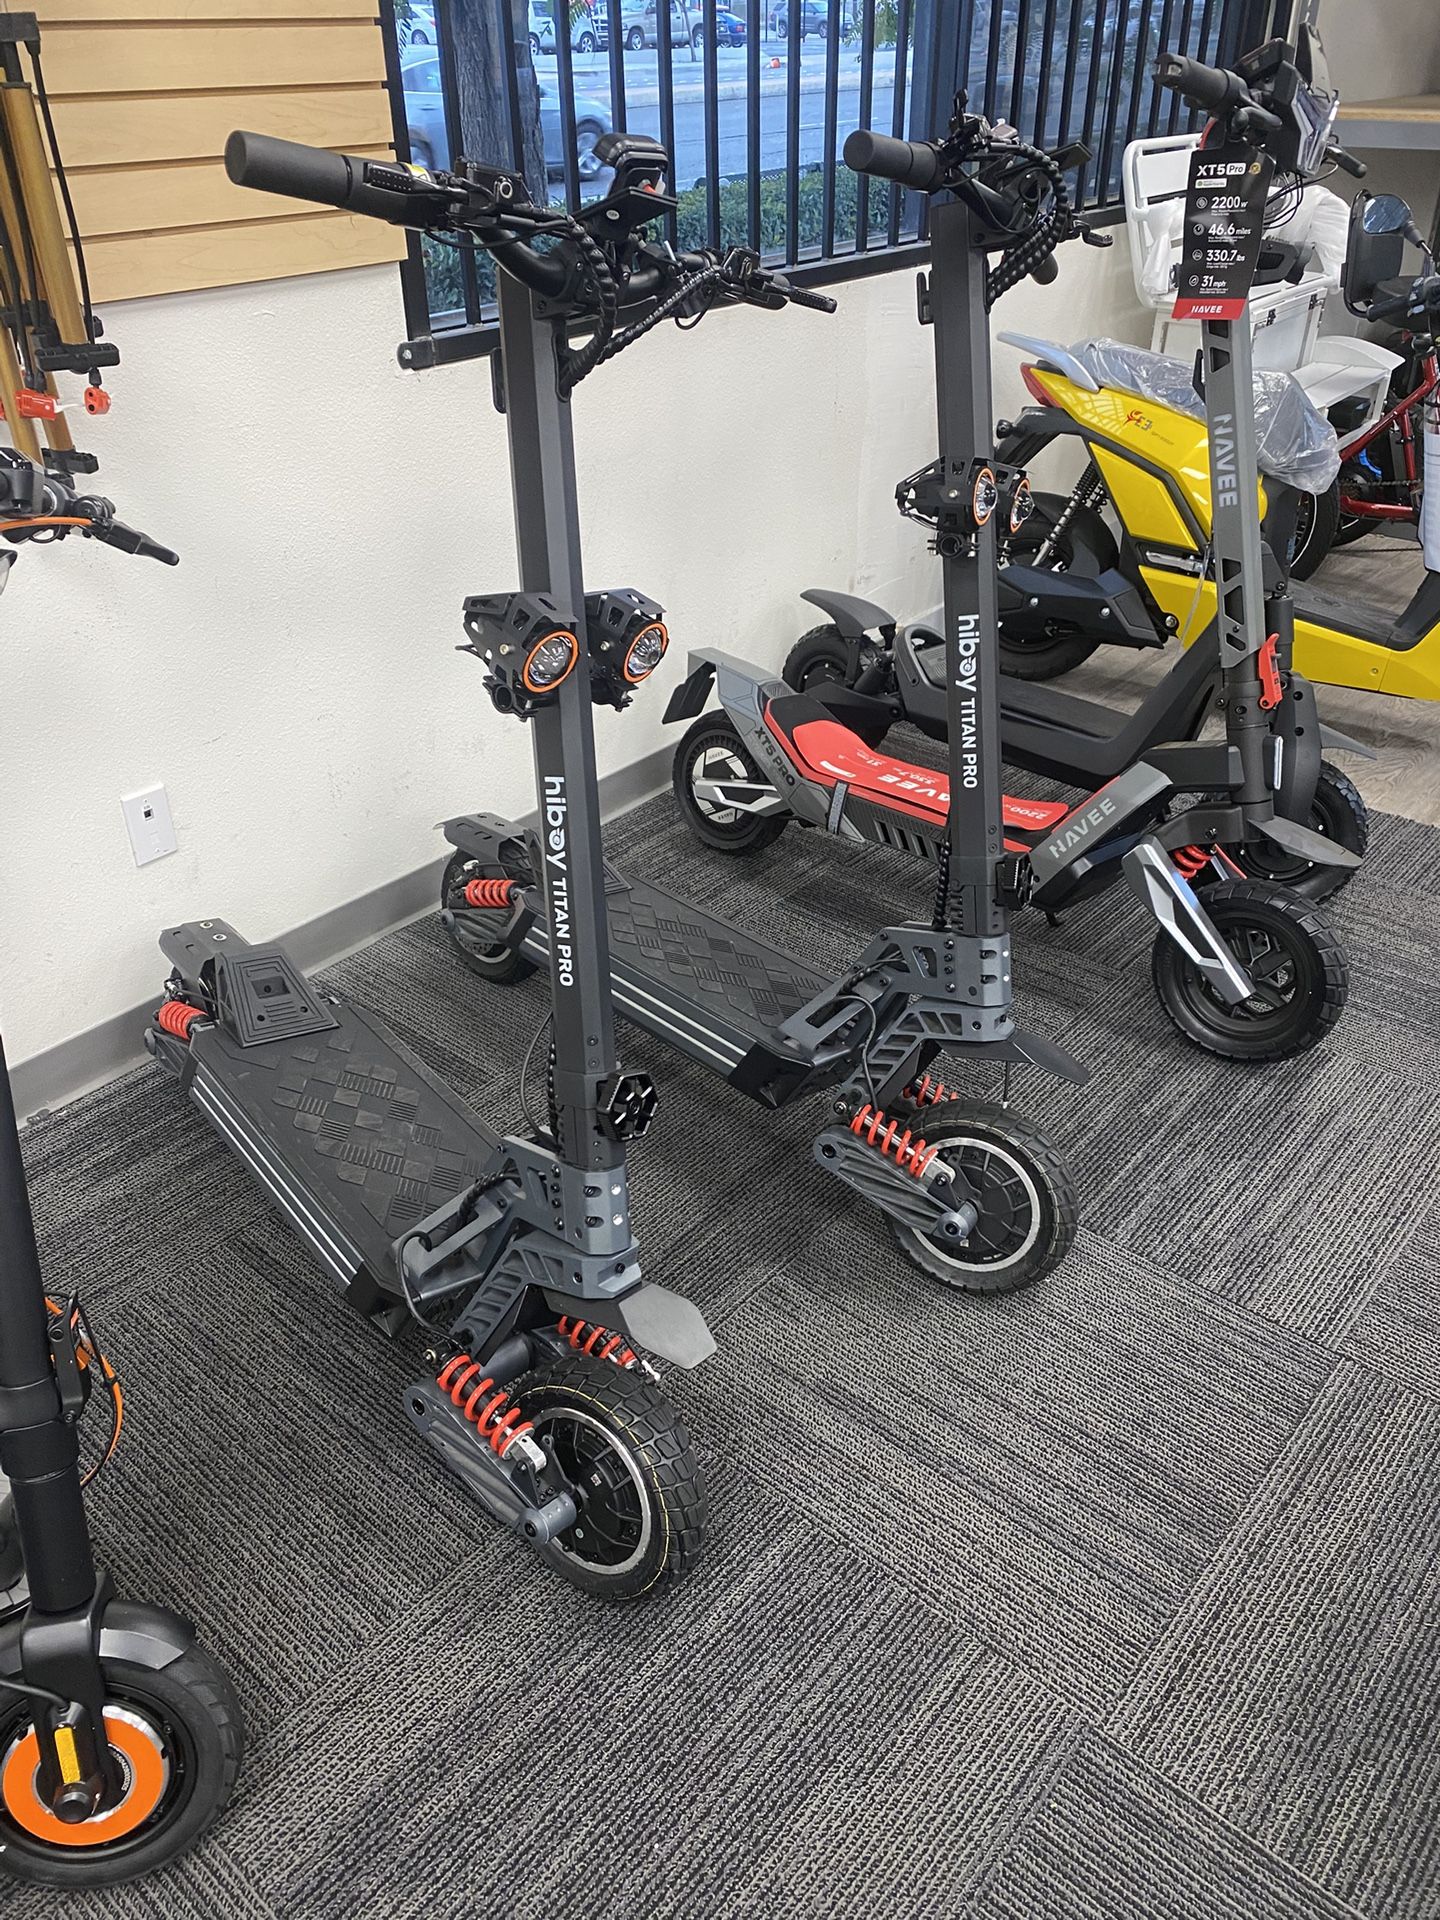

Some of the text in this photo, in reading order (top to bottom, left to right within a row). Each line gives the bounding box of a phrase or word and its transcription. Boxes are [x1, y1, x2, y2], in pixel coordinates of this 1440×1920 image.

[1197, 164, 1244, 176] XT5 Pro
[1208, 222, 1236, 236] 46.6
[1206, 249, 1238, 262] 330.7
[1191, 305, 1223, 314] NAVEE
[1213, 413, 1238, 508] NAVEE
[955, 614, 980, 789] hiboy TITAN PRO
[754, 726, 795, 786] XT5 PRO
[877, 773, 950, 802] AVEE
[1048, 797, 1116, 859] NAVEE
[544, 776, 574, 987] hiboy TITAN PRO
